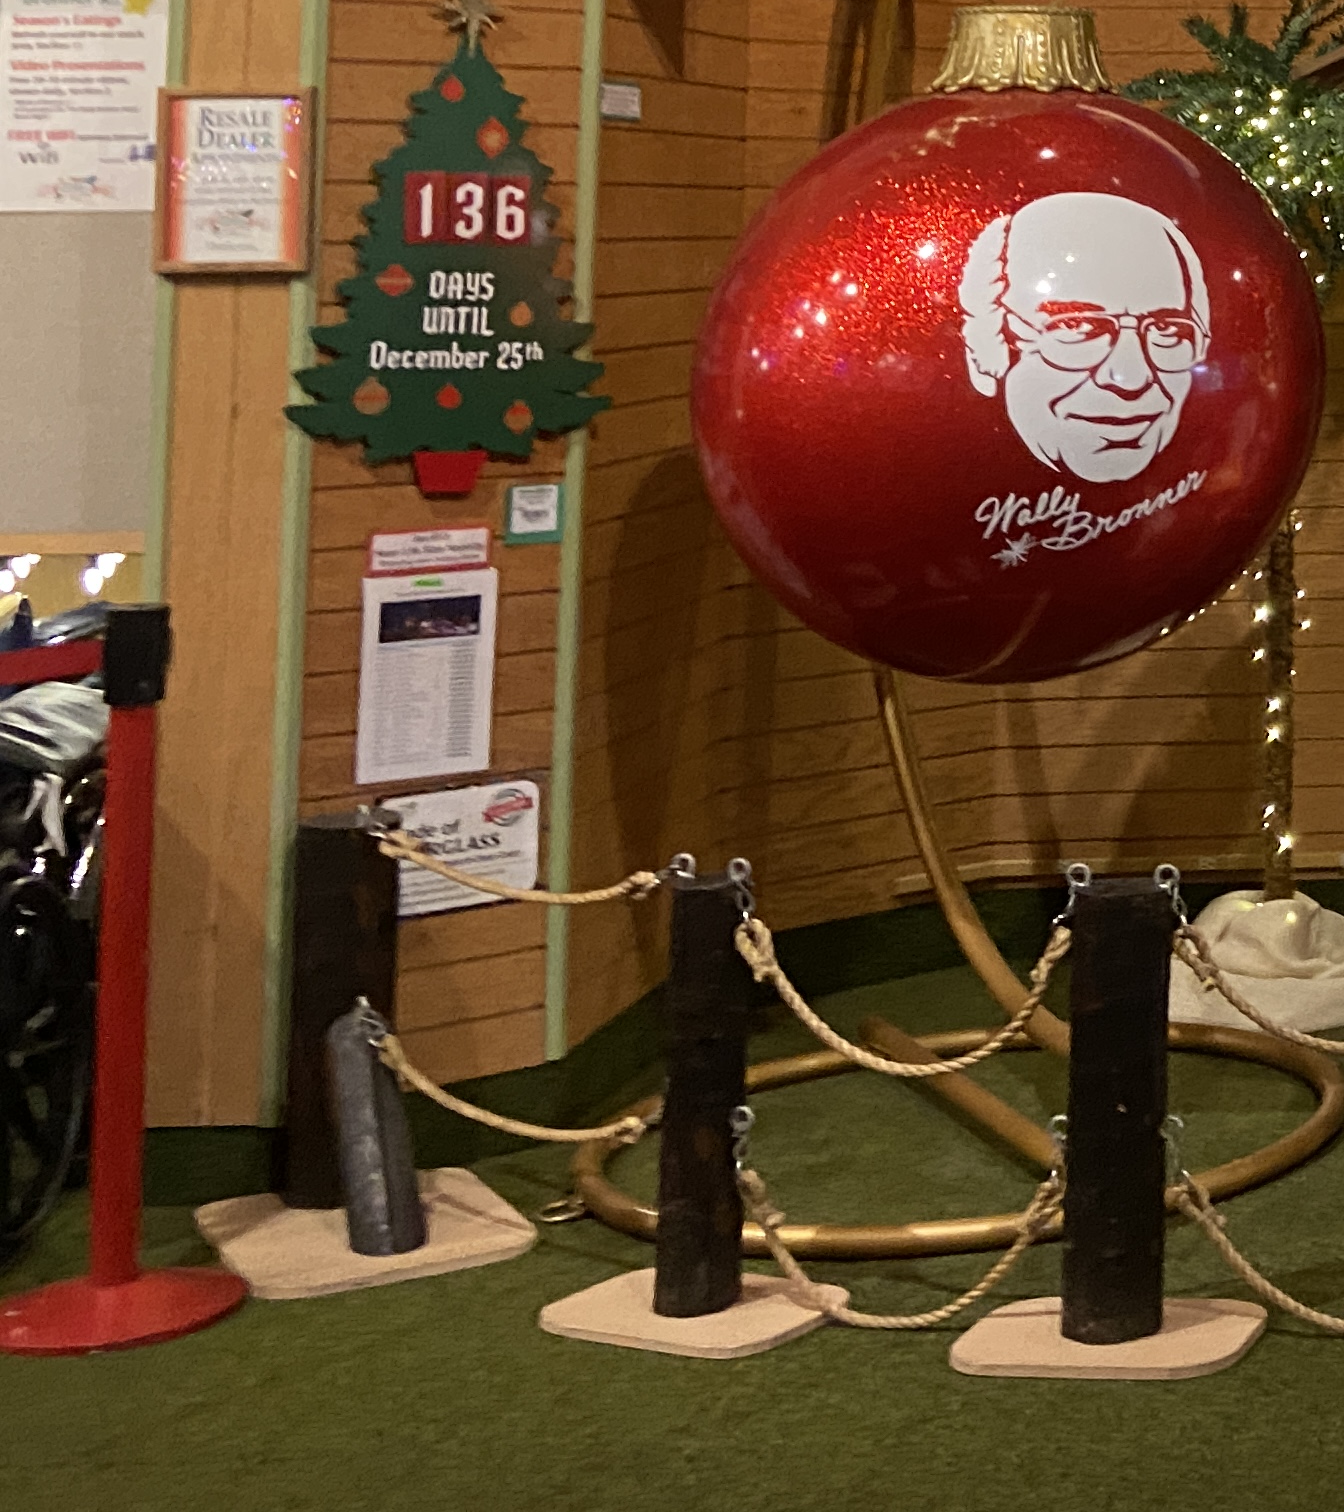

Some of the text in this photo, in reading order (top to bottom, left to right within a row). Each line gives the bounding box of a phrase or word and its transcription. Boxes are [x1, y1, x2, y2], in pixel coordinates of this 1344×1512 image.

[201, 106, 272, 128] RESALE
[198, 127, 275, 149] DEALER
[418, 182, 526, 240] 136
[428, 270, 495, 301] DAYS
[421, 306, 495, 336] UNTIL
[369, 340, 545, 370] December 25th
[974, 469, 1208, 551] Wally Bronner
